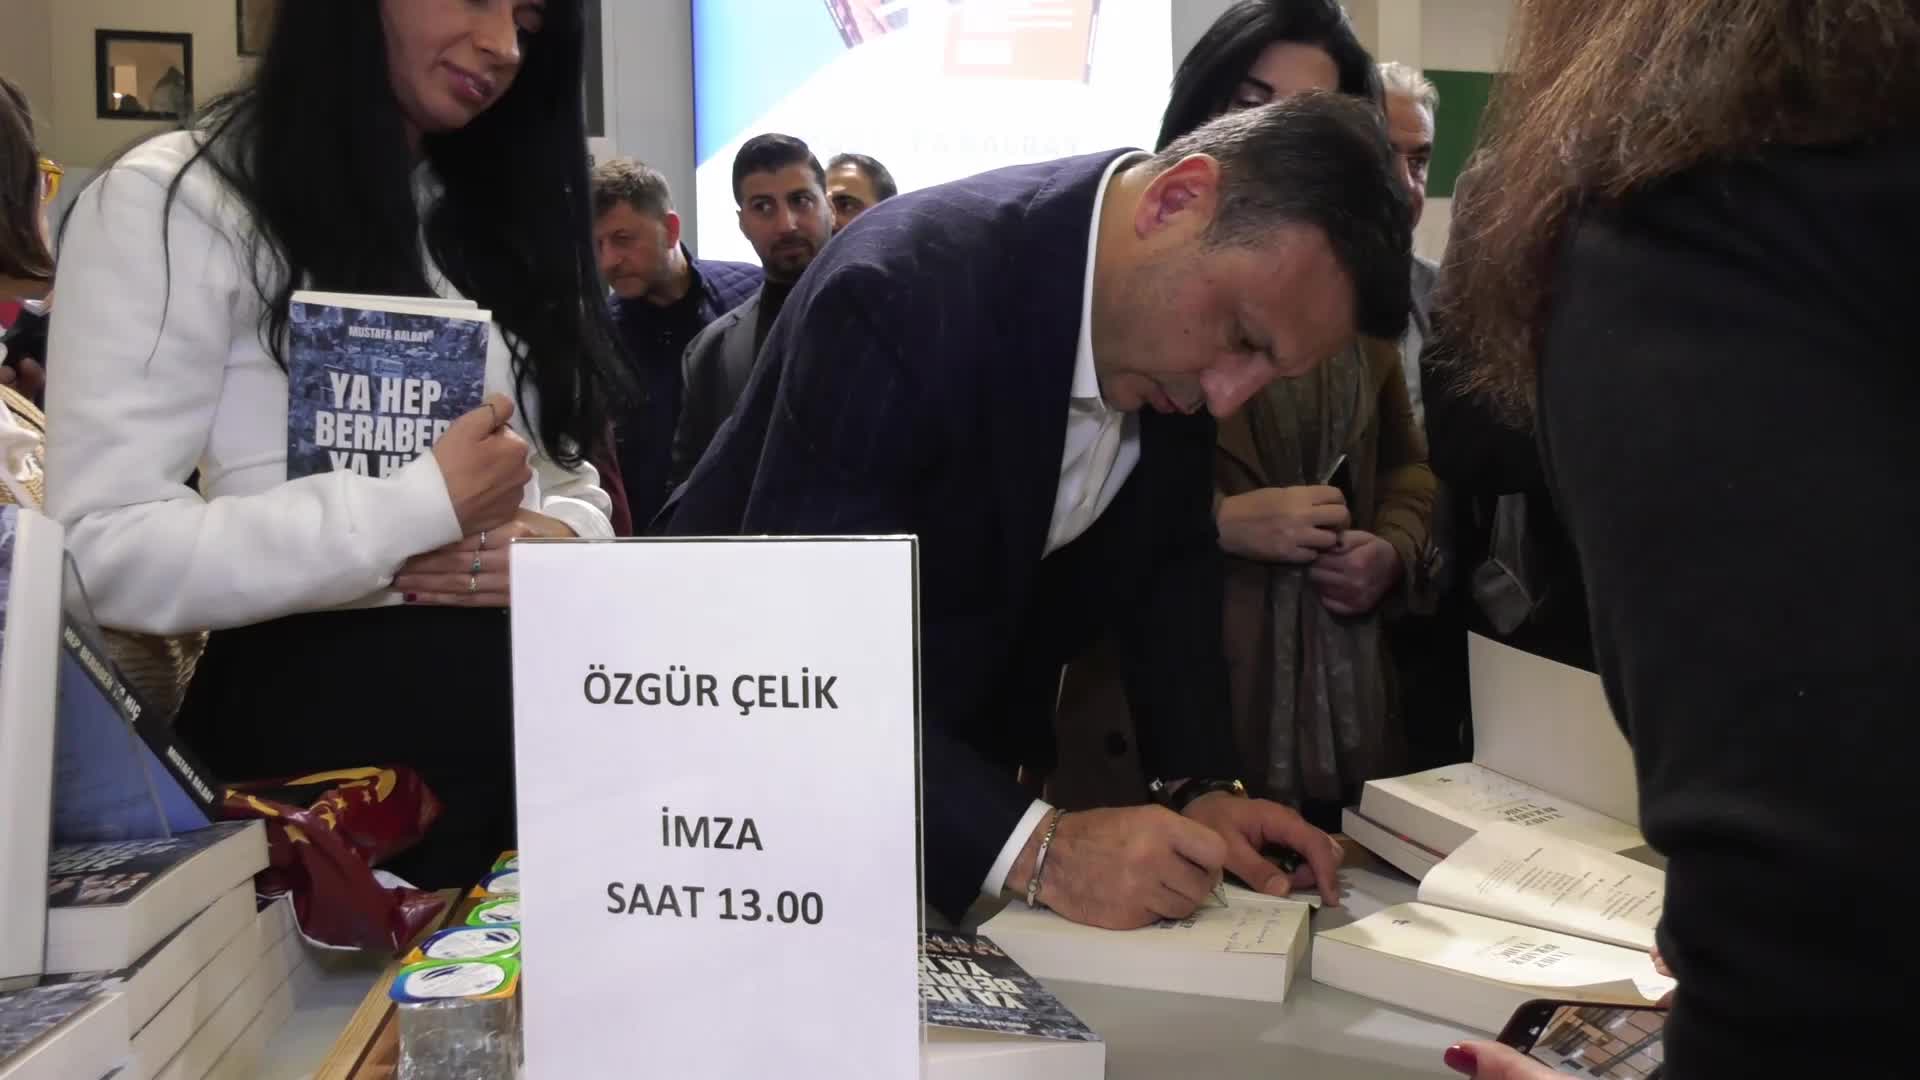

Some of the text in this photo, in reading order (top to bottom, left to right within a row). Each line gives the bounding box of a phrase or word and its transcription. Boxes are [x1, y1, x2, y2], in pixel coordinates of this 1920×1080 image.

[349, 326, 392, 341] MUSTAFA
[329, 371, 442, 416] YA HEP
[329, 450, 369, 477] YA
[583, 664, 839, 716] ÖZGÜR ÇELİK
[662, 806, 764, 851] İMZA
[607, 882, 824, 925] SAAT 13.00
[939, 958, 993, 977] YA
[919, 986, 1028, 1009] YA HE
